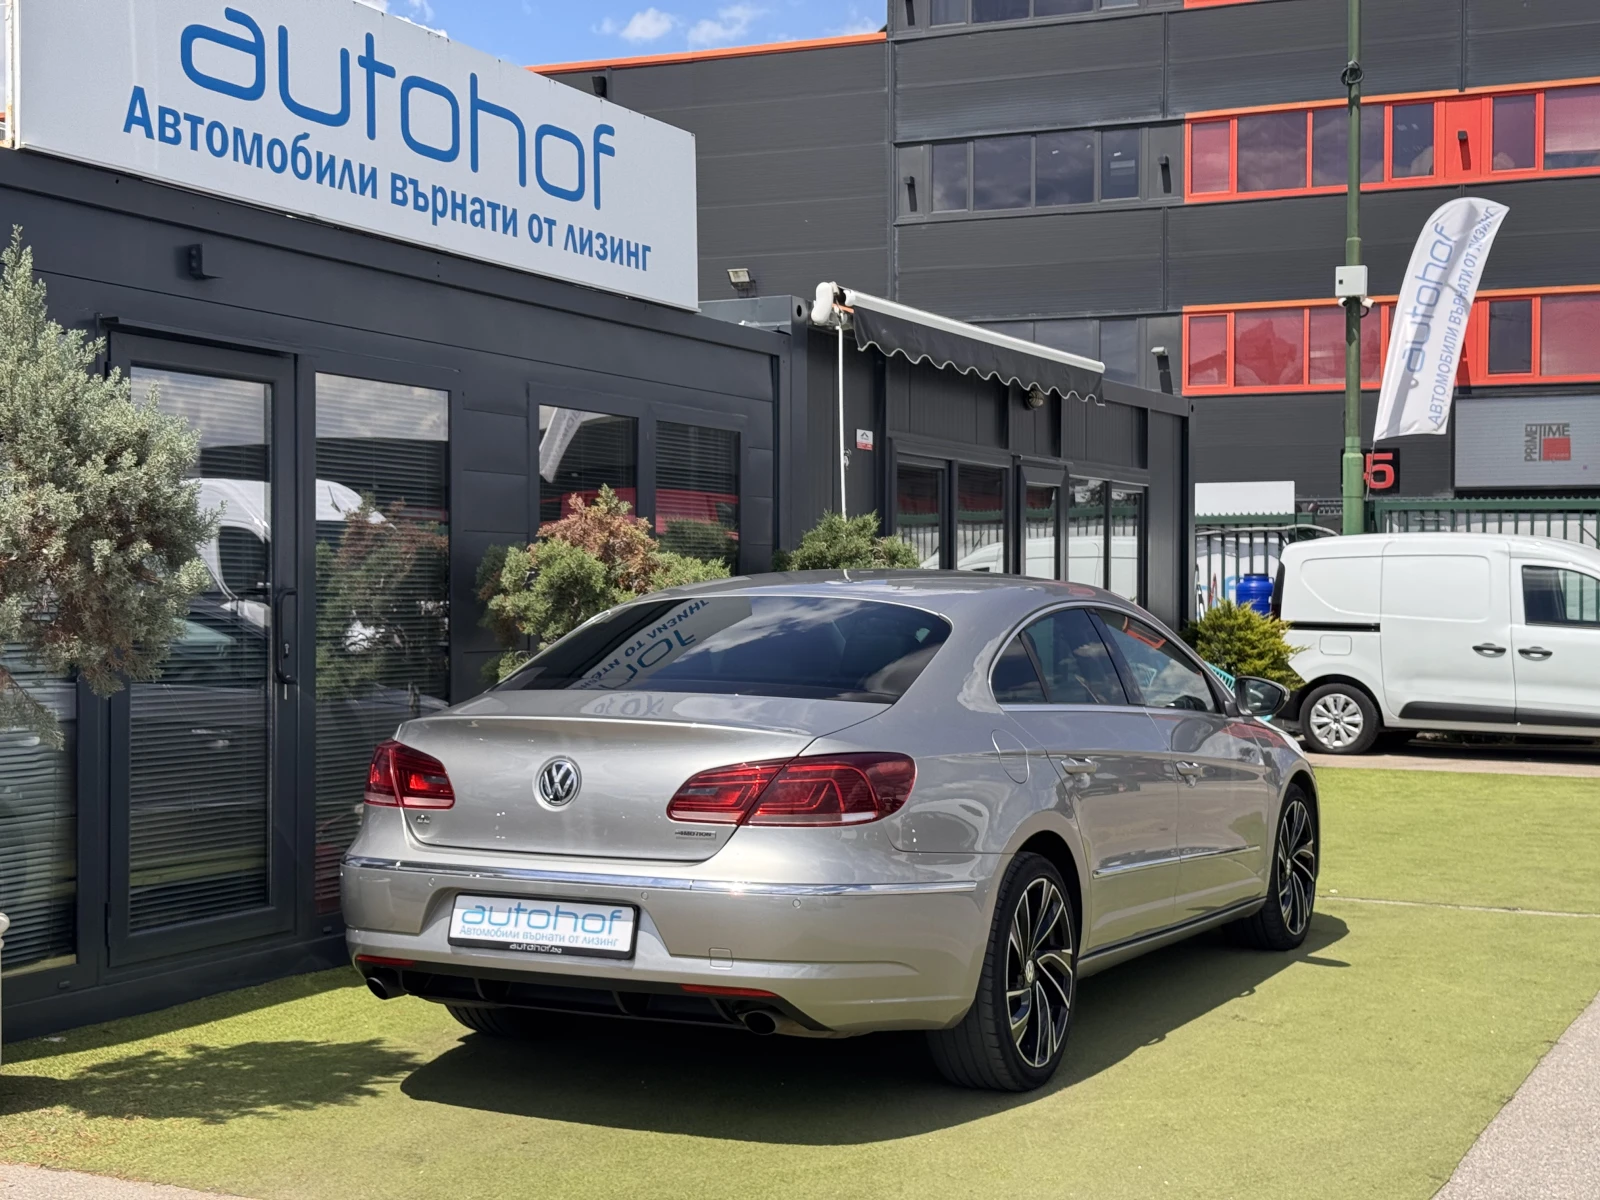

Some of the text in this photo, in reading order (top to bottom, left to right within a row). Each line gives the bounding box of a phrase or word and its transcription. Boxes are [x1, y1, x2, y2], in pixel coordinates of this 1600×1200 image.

[123, 85, 652, 271] Автомобили върнати от лизинг
[180, 7, 616, 210] autohof
[1402, 222, 1455, 372] autohof
[1428, 326, 1460, 426] АВТОМОБИЛИ
[1448, 268, 1474, 326] ВЪРНАТИ
[1463, 252, 1479, 268] ОТ
[459, 925, 619, 947] Автомобили върнати от лизинг
[461, 902, 623, 935] autohof
